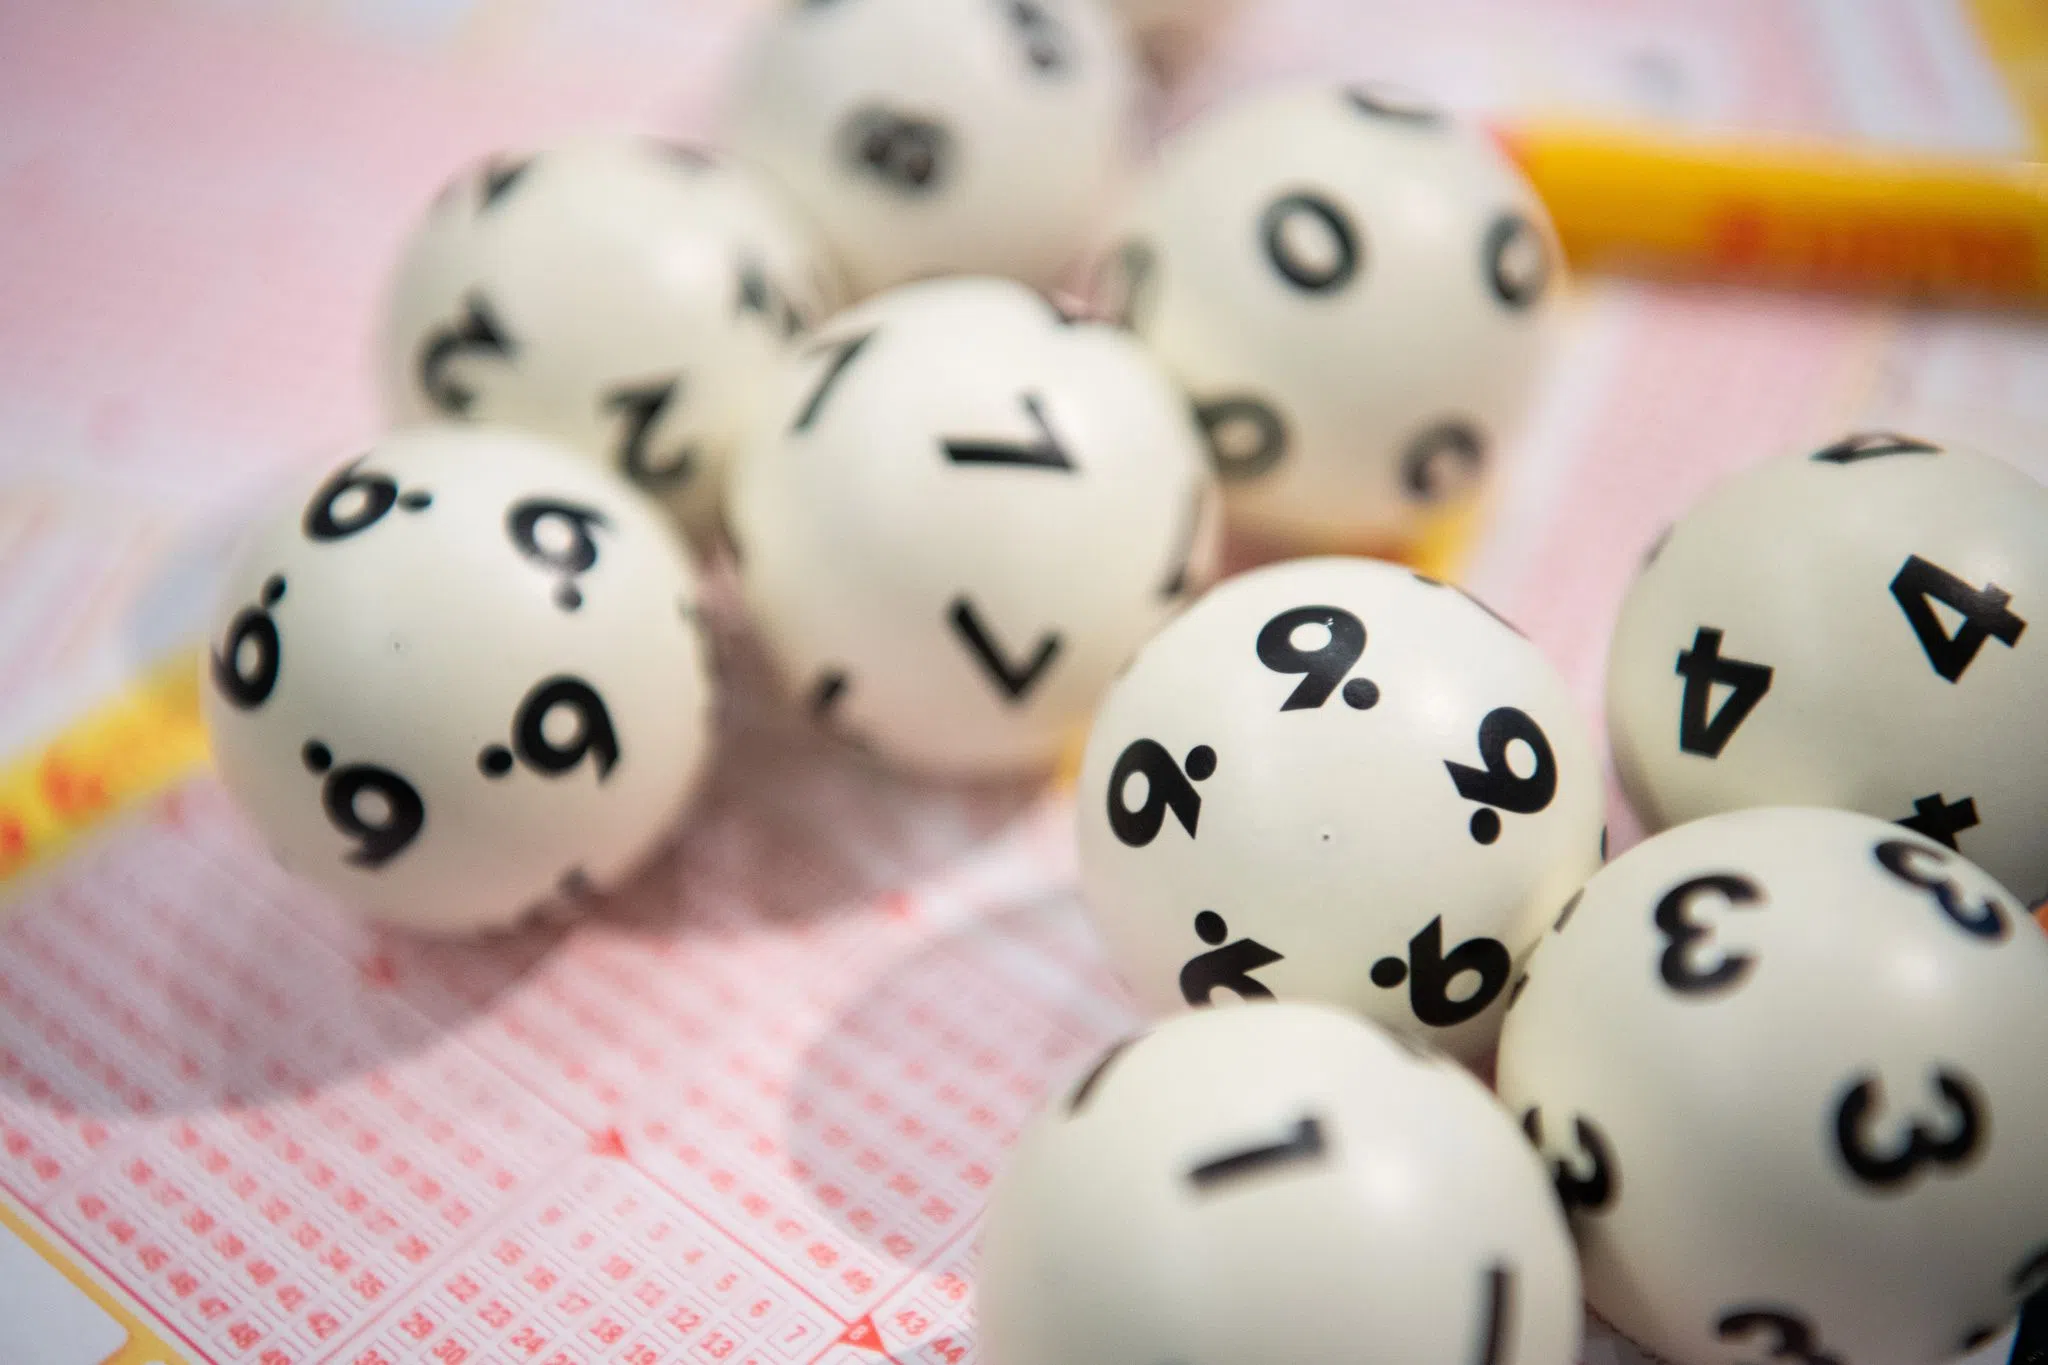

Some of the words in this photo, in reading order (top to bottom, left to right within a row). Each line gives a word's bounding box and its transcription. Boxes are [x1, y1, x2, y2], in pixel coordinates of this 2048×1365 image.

[1262, 188, 1366, 296] 0
[415, 285, 520, 420] 2
[600, 370, 700, 490] 2
[1887, 553, 2028, 686] 4
[1674, 626, 1775, 760] 4
[1653, 873, 1759, 996] 3
[1873, 834, 2014, 943] 3
[1829, 1070, 1989, 1197] 3
[701, 1331, 734, 1359] 13
[895, 1310, 930, 1337] 43
